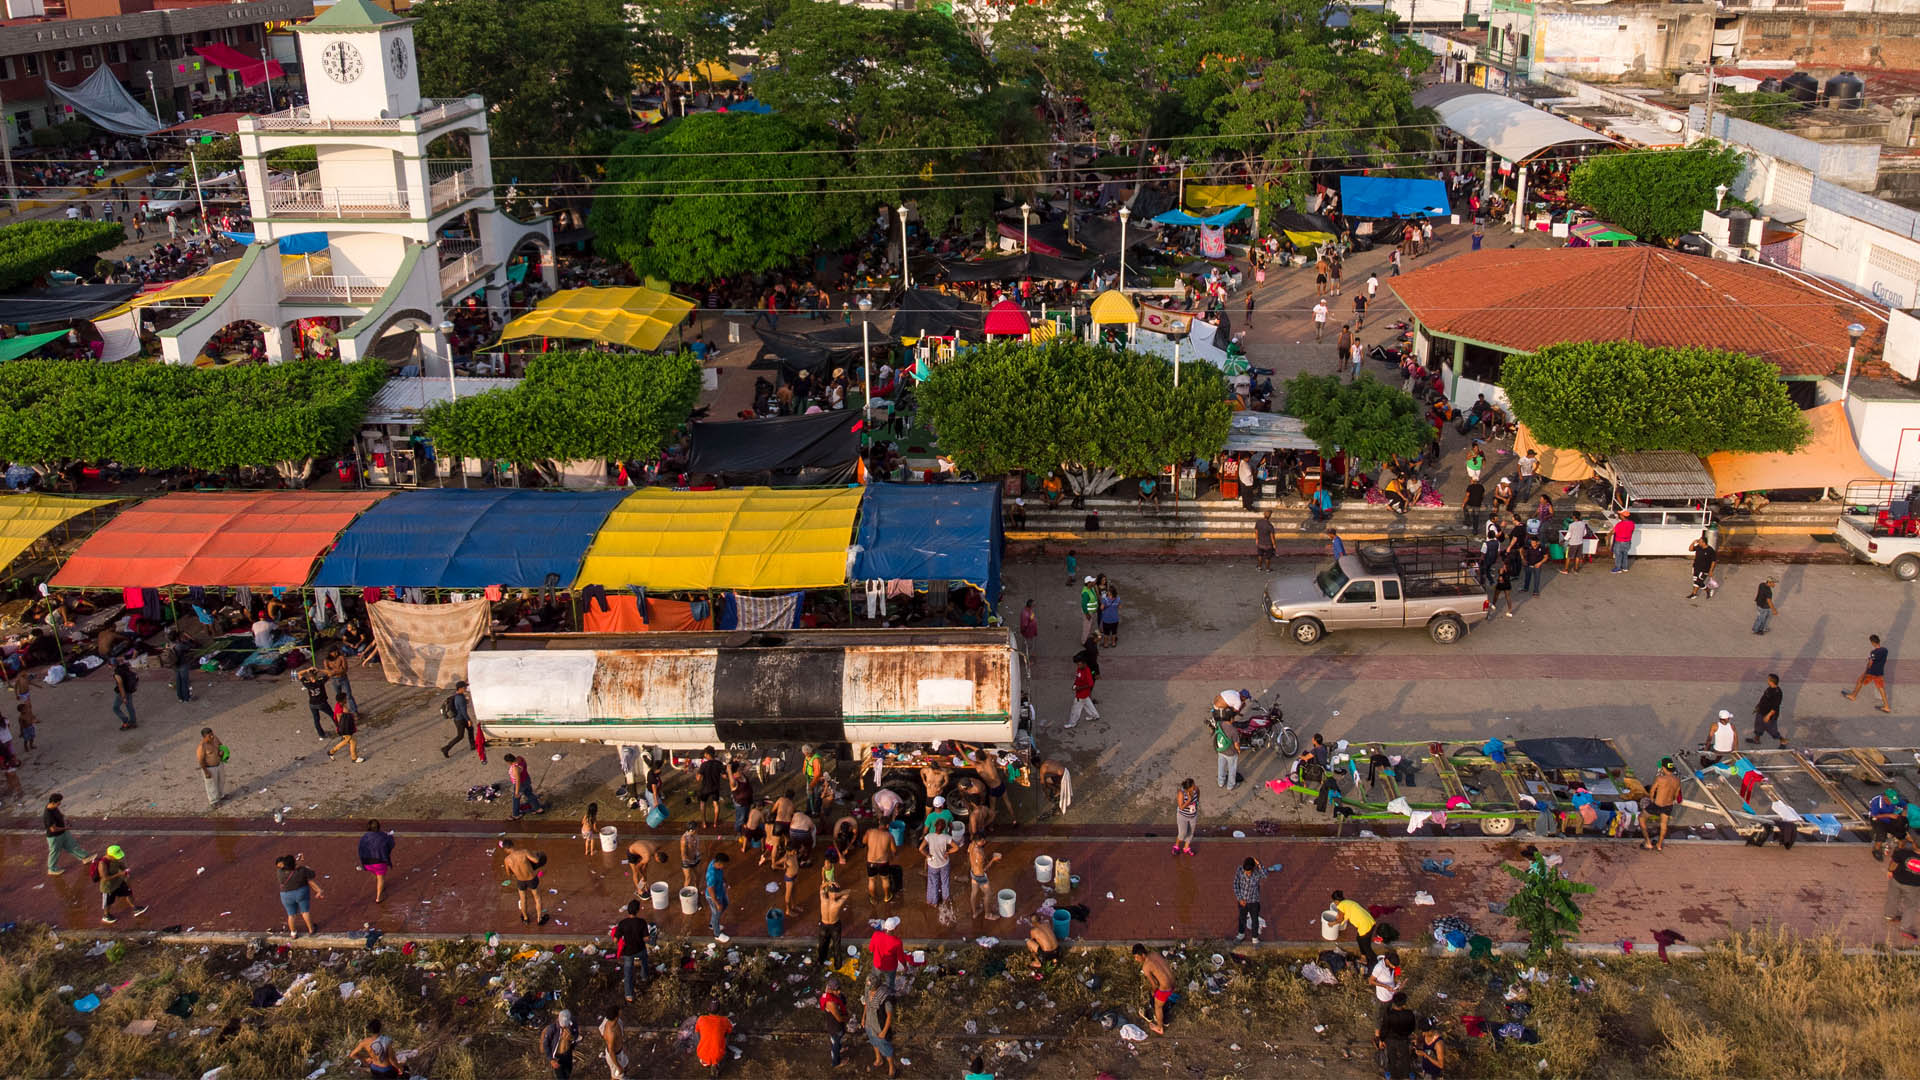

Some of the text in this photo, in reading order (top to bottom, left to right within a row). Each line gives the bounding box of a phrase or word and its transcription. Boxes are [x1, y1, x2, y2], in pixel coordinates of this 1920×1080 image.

[36, 23, 121, 42] PALACIO
[1872, 281, 1903, 306] Corona
[730, 742, 757, 751] AGUA
